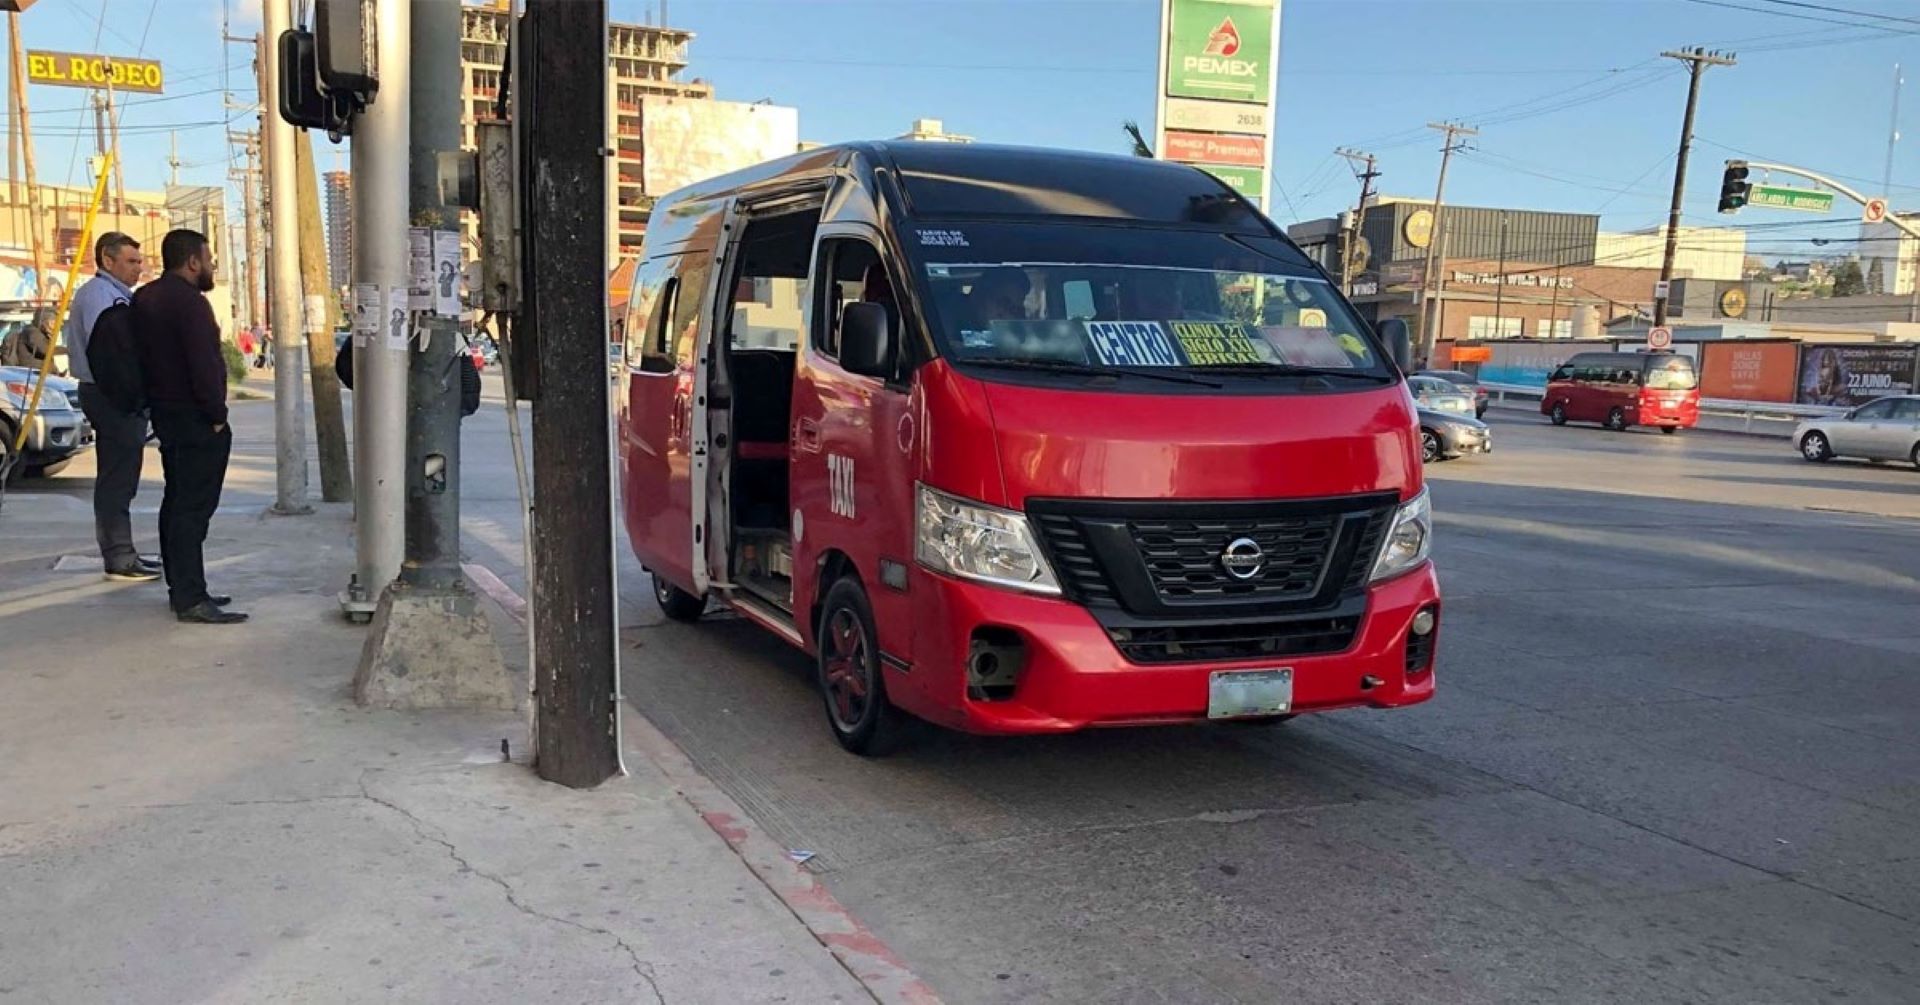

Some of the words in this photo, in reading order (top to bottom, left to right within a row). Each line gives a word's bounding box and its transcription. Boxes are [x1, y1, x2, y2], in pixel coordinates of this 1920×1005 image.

[29, 55, 65, 79] EL
[70, 57, 161, 87] RODEO
[1183, 56, 1258, 77] PEMEX
[1237, 114, 1262, 126] 2638
[1507, 273, 1536, 287] WILD
[1174, 323, 1225, 338] CLINICA
[1225, 323, 1244, 338] 27
[1090, 323, 1175, 366] CENTRO
[1181, 339, 1225, 352] SIGLO
[1226, 339, 1254, 352] XXI
[1848, 372, 1861, 388] 22
[1862, 374, 1892, 388] JUNIO
[828, 453, 855, 519] TAXI
